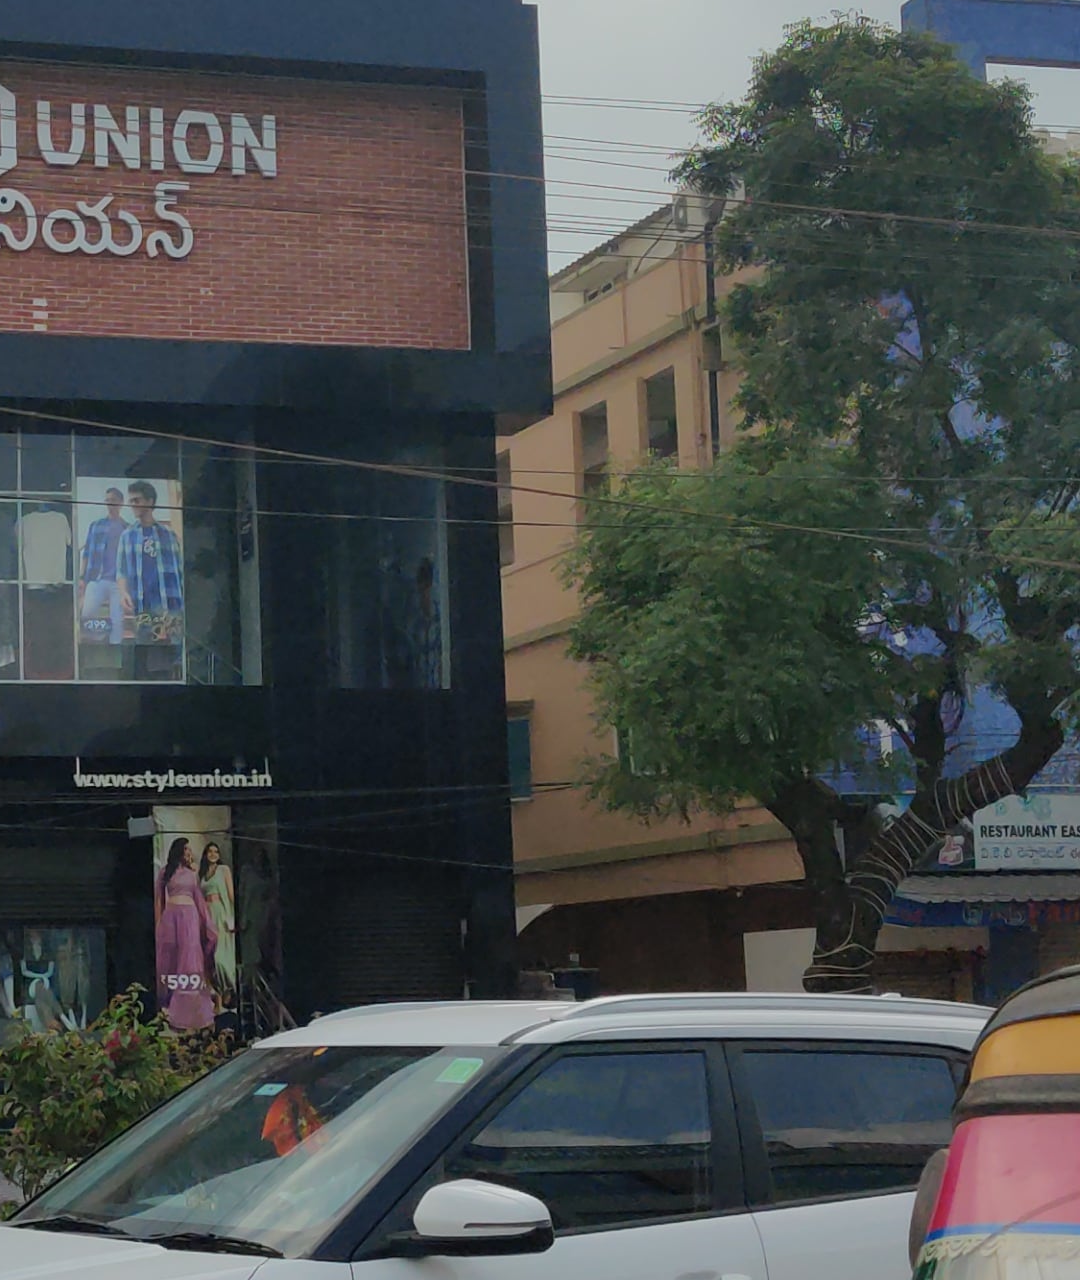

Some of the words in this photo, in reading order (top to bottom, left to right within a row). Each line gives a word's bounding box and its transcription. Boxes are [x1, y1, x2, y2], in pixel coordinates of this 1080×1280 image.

[36, 99, 278, 178] UNION
[73, 768, 273, 793] www.styleunion.in
[980, 824, 1058, 839] RESTAURANT
